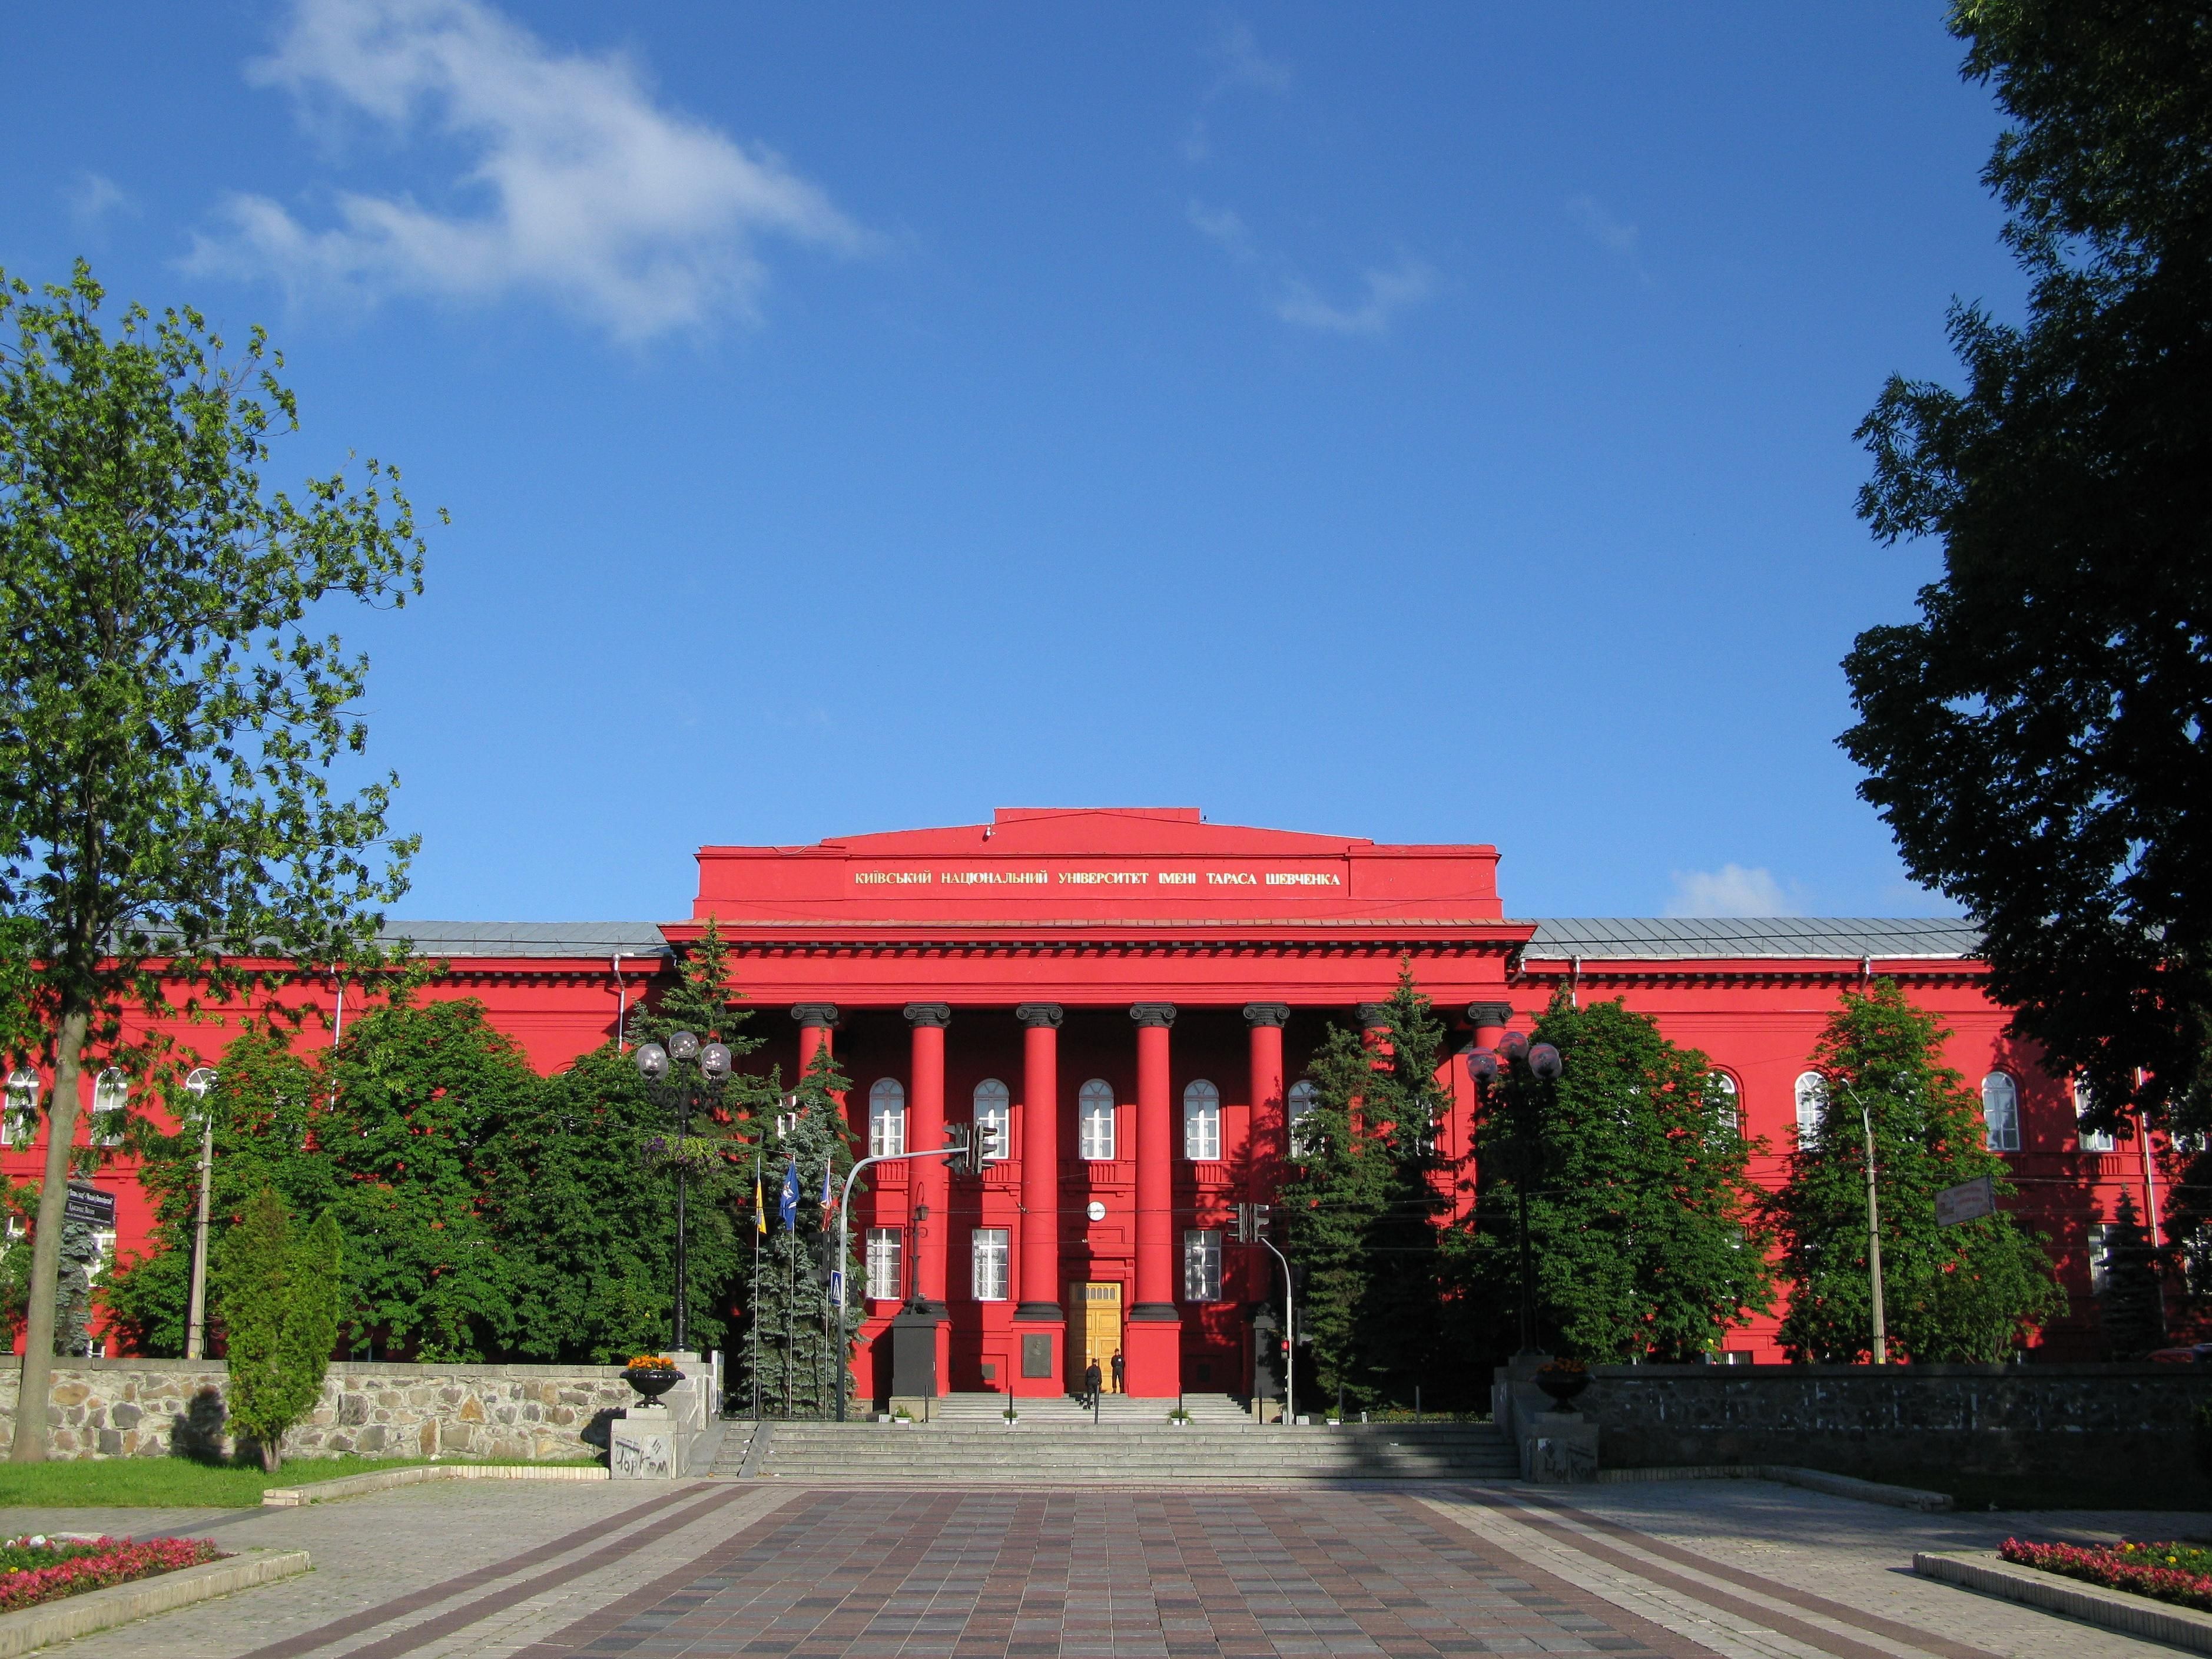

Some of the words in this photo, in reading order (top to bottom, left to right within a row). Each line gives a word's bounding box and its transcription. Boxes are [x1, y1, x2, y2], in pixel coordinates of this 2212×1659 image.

[855, 870, 932, 884] КИЇВСЬКИЙ
[941, 870, 1048, 886] НАЦІОНАЛЬНИЙ
[1058, 872, 1149, 884] УНІВЕРСИТЕТ
[1159, 872, 1196, 884] ІМЕНІ
[1206, 873, 1257, 885] ТАРАСА
[1265, 873, 1341, 885] ШЕВЧЕНКА
